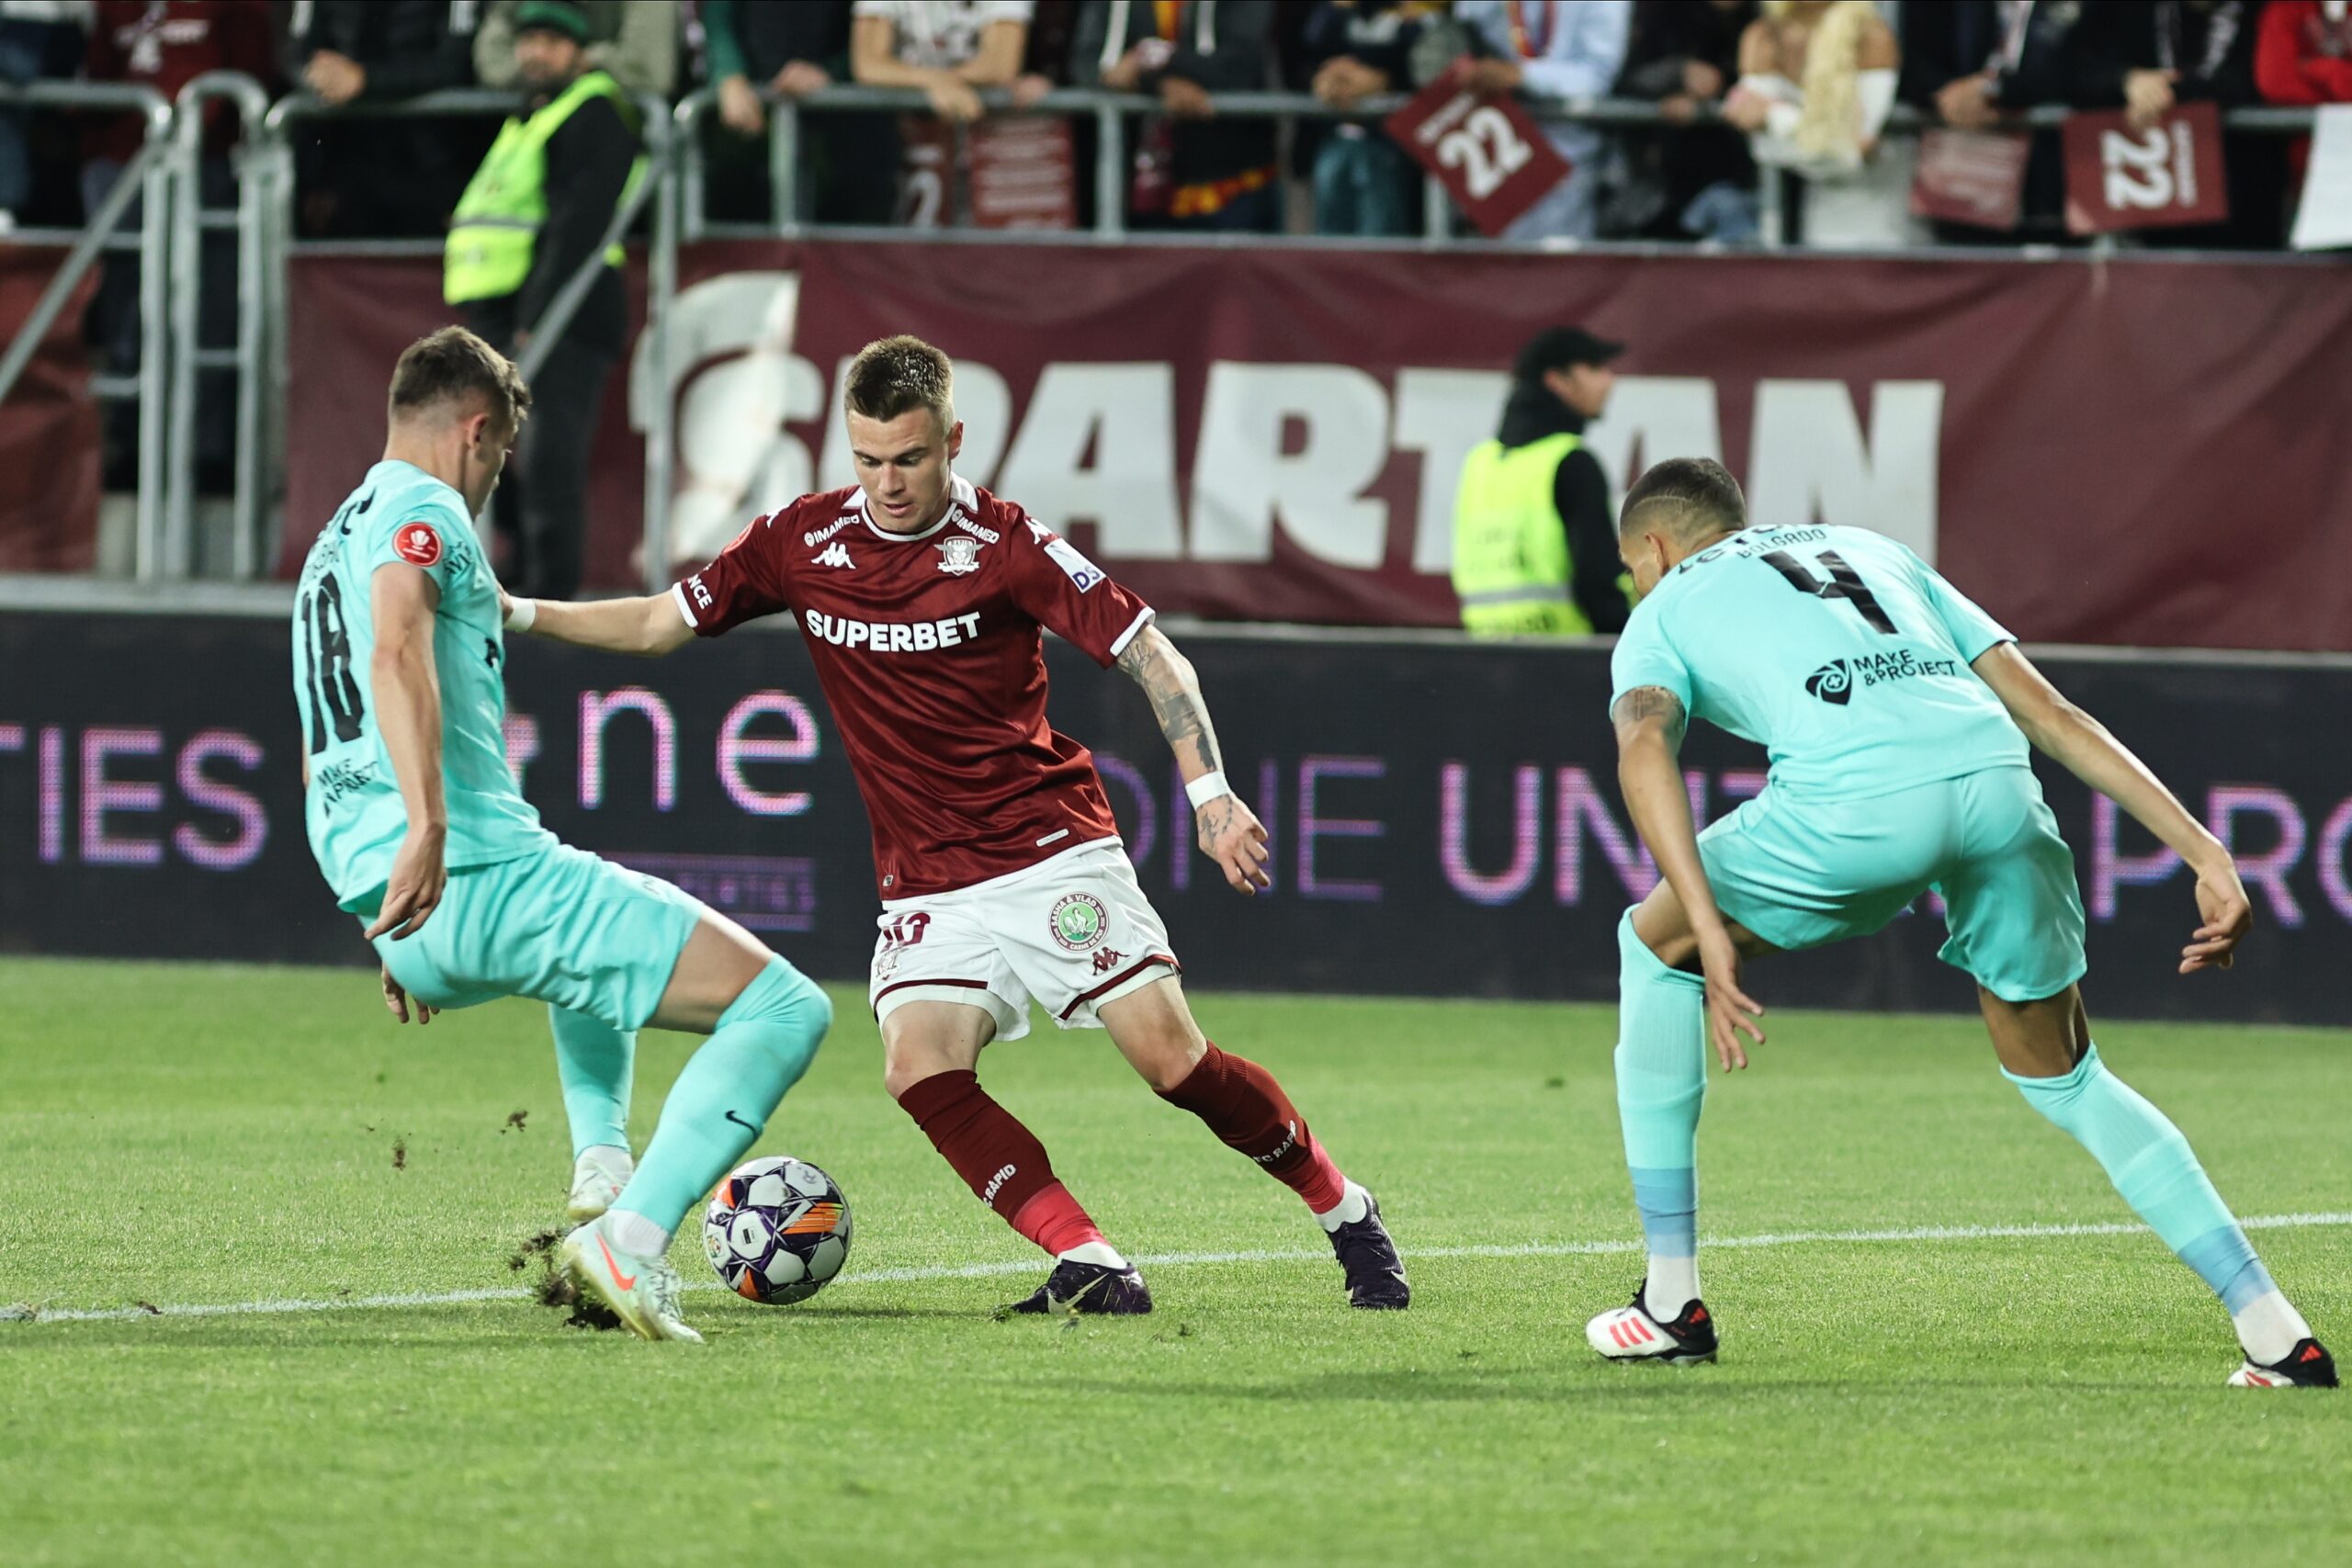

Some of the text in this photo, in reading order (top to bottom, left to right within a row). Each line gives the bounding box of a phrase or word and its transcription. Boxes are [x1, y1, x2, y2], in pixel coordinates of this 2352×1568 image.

[1438, 106, 1533, 200] 22
[2100, 126, 2175, 210] 22
[805, 608, 981, 653] SUPERBET
[1759, 549, 1899, 635] 4
[1852, 649, 1915, 671] MAKE
[504, 684, 820, 816] ne
[0, 722, 268, 871] IES
[2090, 782, 2352, 927] PR
[985, 1163, 1016, 1201] RAPID
